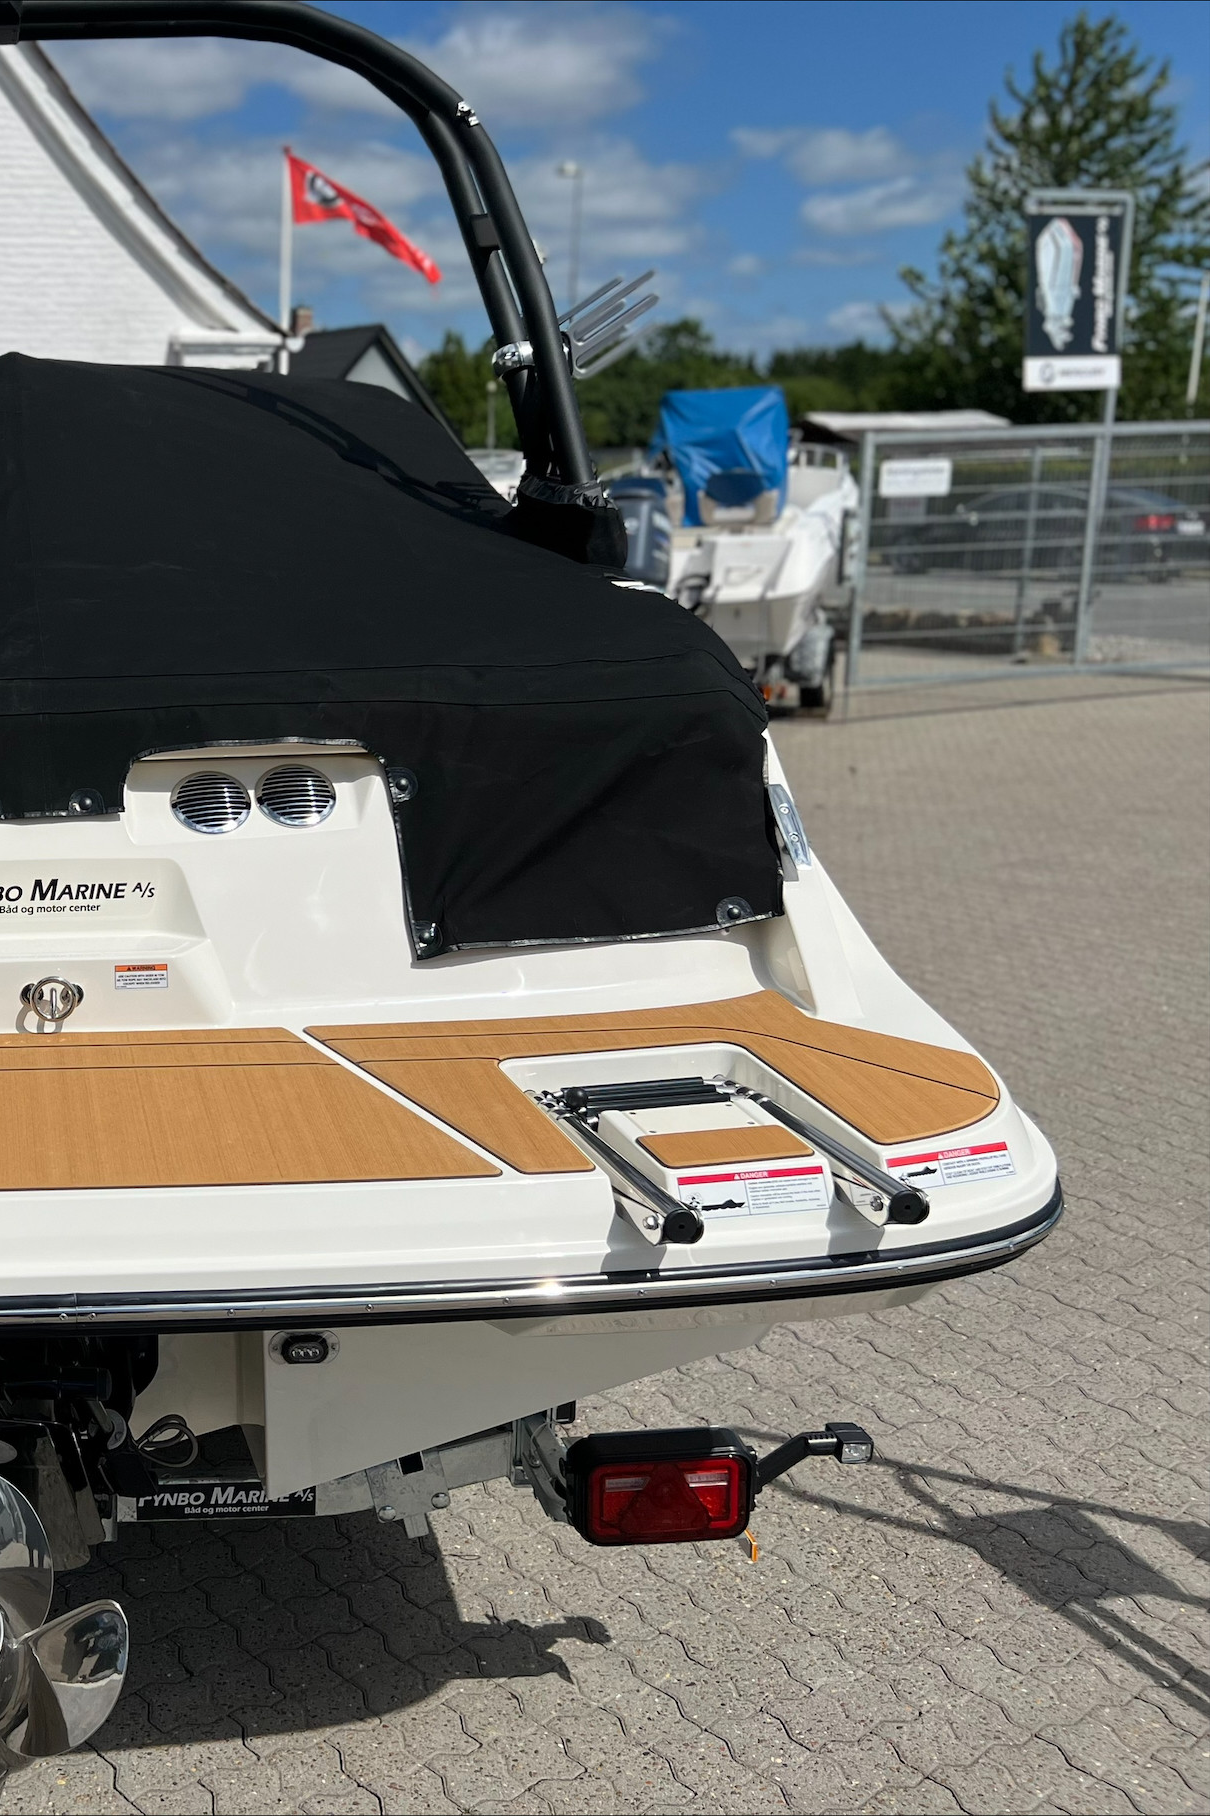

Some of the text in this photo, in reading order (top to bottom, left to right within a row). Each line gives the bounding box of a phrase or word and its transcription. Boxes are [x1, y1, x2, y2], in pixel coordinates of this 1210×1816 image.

[30, 878, 127, 901] MARINE
[132, 882, 155, 898] A/S
[0, 904, 101, 915] Båd og motor center
[943, 1149, 970, 1158] DANGER
[740, 1171, 769, 1179] DANGER
[184, 1504, 269, 1515] Båd og motor center
